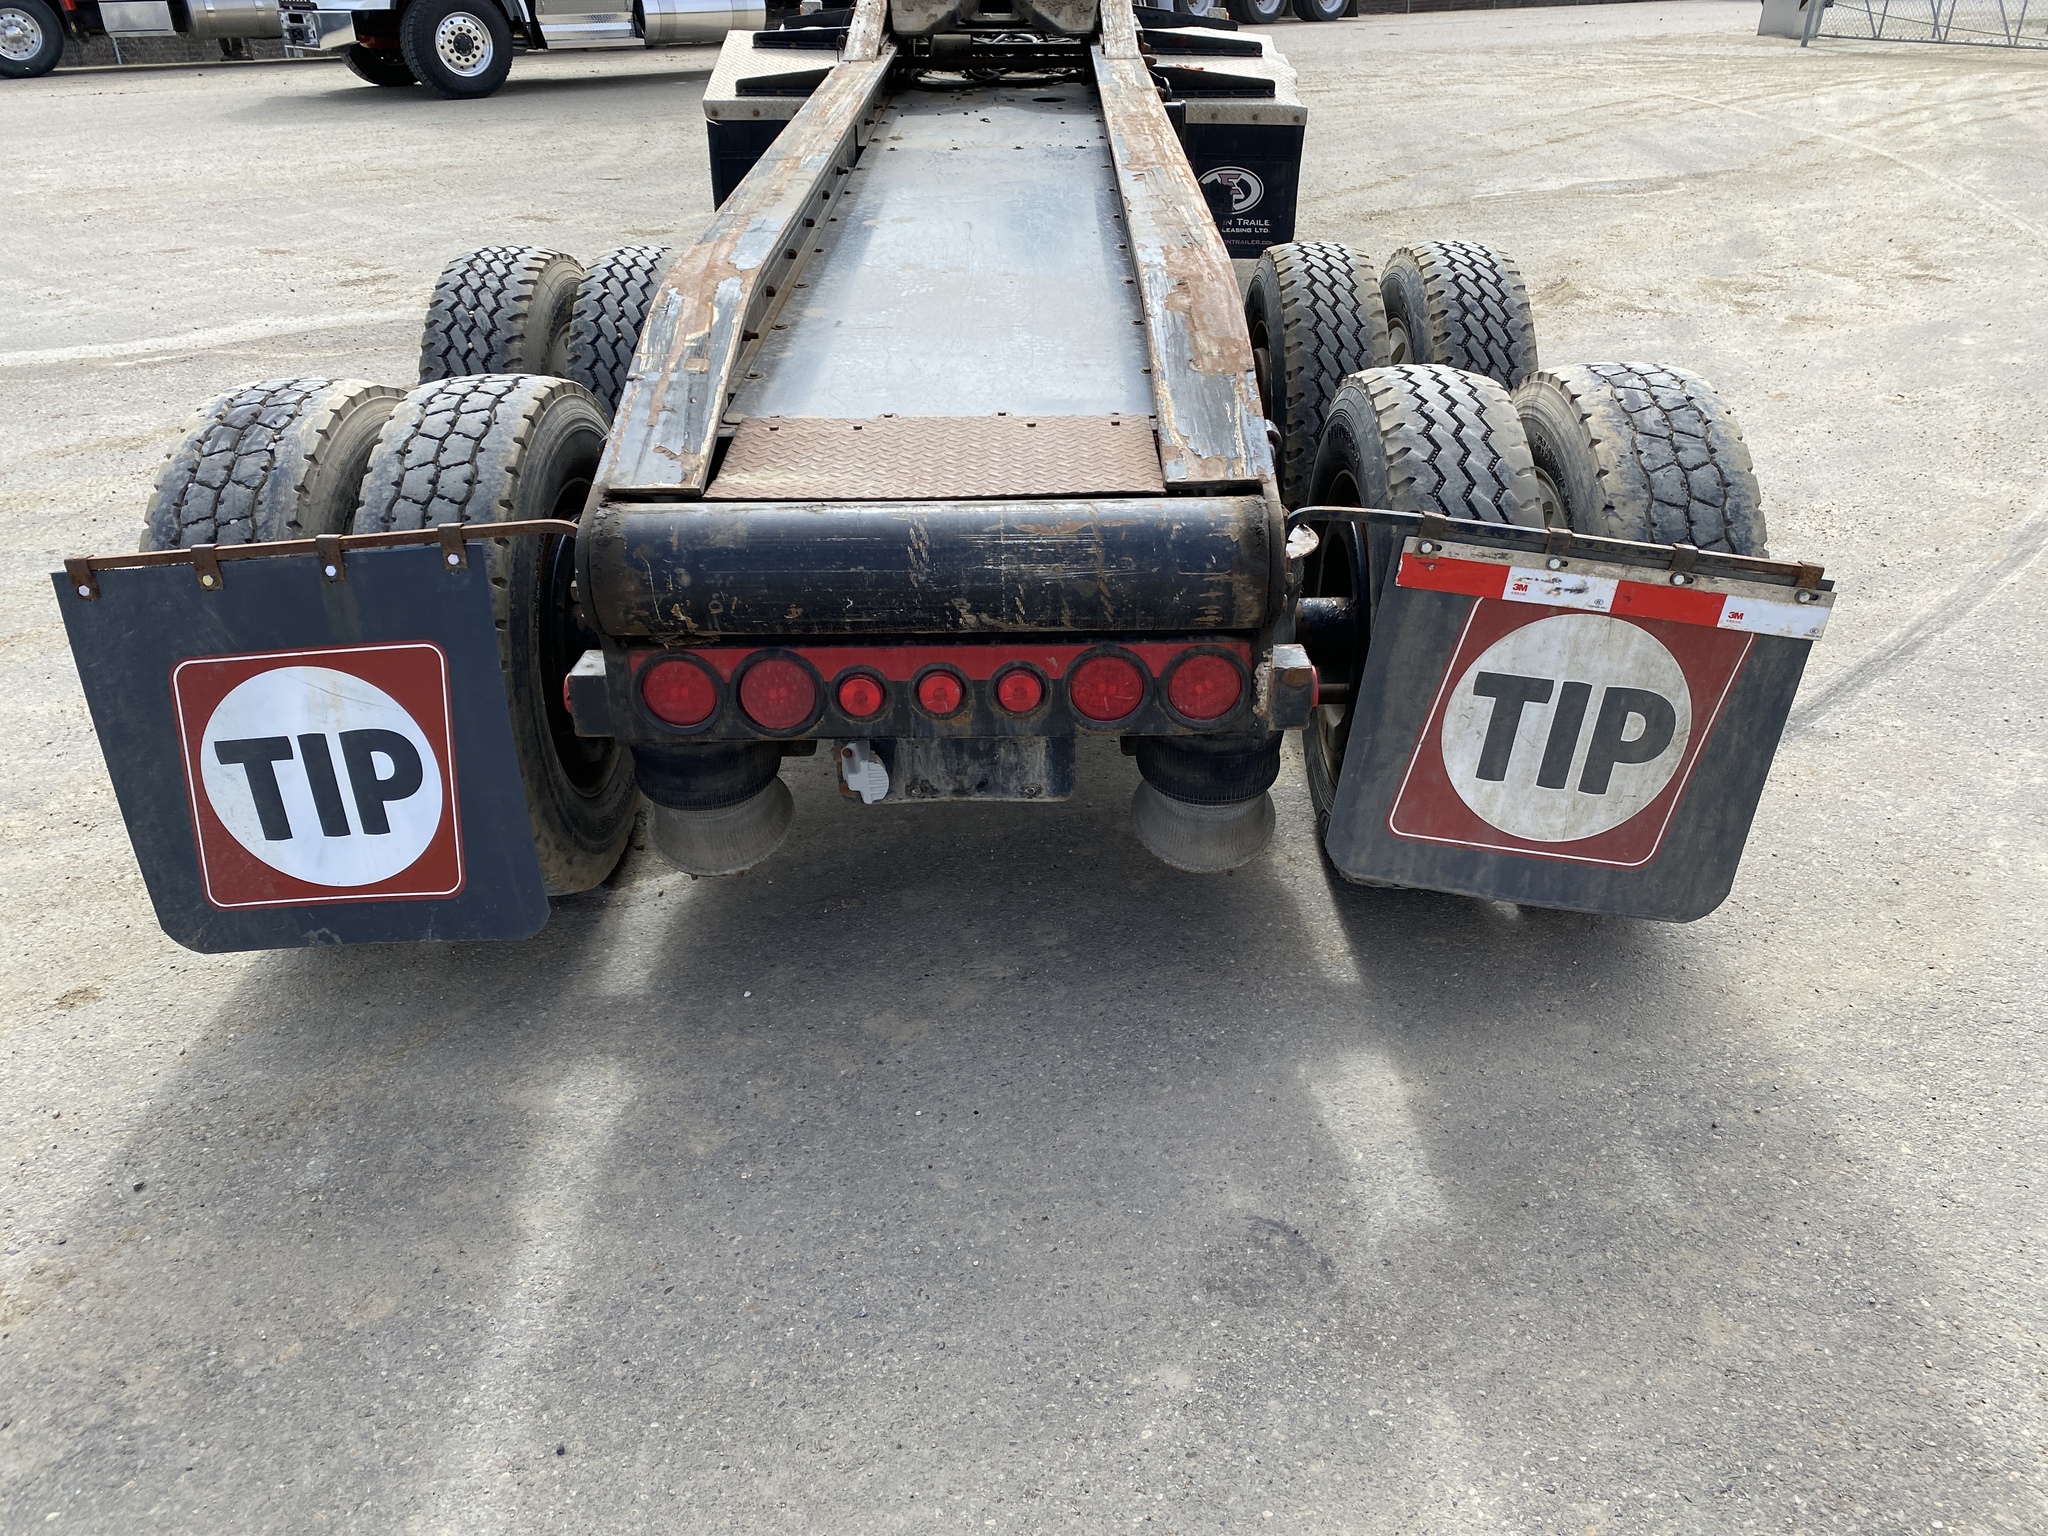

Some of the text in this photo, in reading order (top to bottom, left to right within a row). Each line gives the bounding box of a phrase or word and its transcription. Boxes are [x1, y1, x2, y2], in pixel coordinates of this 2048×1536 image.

[1236, 217, 1271, 226] TRAILE
[1512, 583, 1529, 592] 3M
[1728, 611, 1744, 620] 3M
[1473, 671, 1677, 795] TIP
[213, 728, 424, 841] TIP
